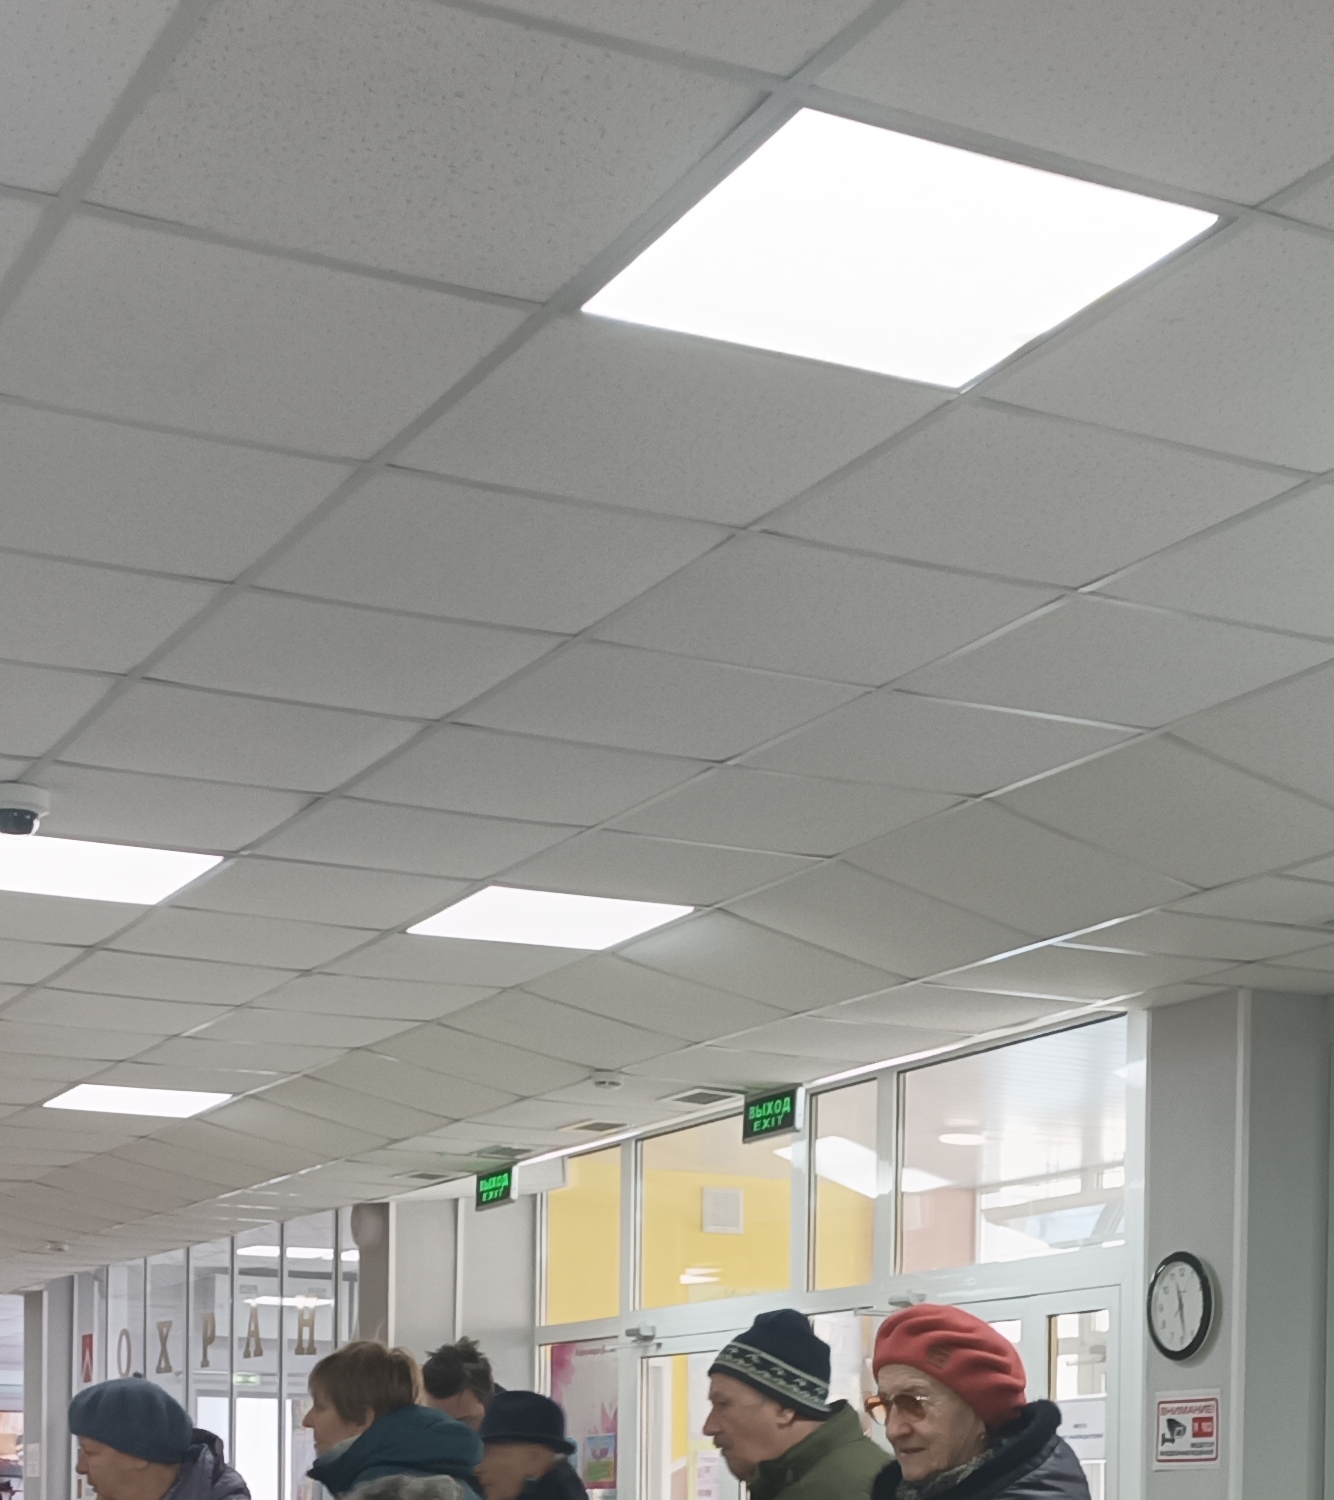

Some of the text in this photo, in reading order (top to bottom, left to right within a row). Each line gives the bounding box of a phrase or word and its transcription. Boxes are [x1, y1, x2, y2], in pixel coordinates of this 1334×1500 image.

[748, 1096, 791, 1120] ВЫХОД
[753, 1113, 785, 1132] EXIT
[479, 1173, 509, 1192] ВЫХОД
[482, 1187, 504, 1202] EXIT
